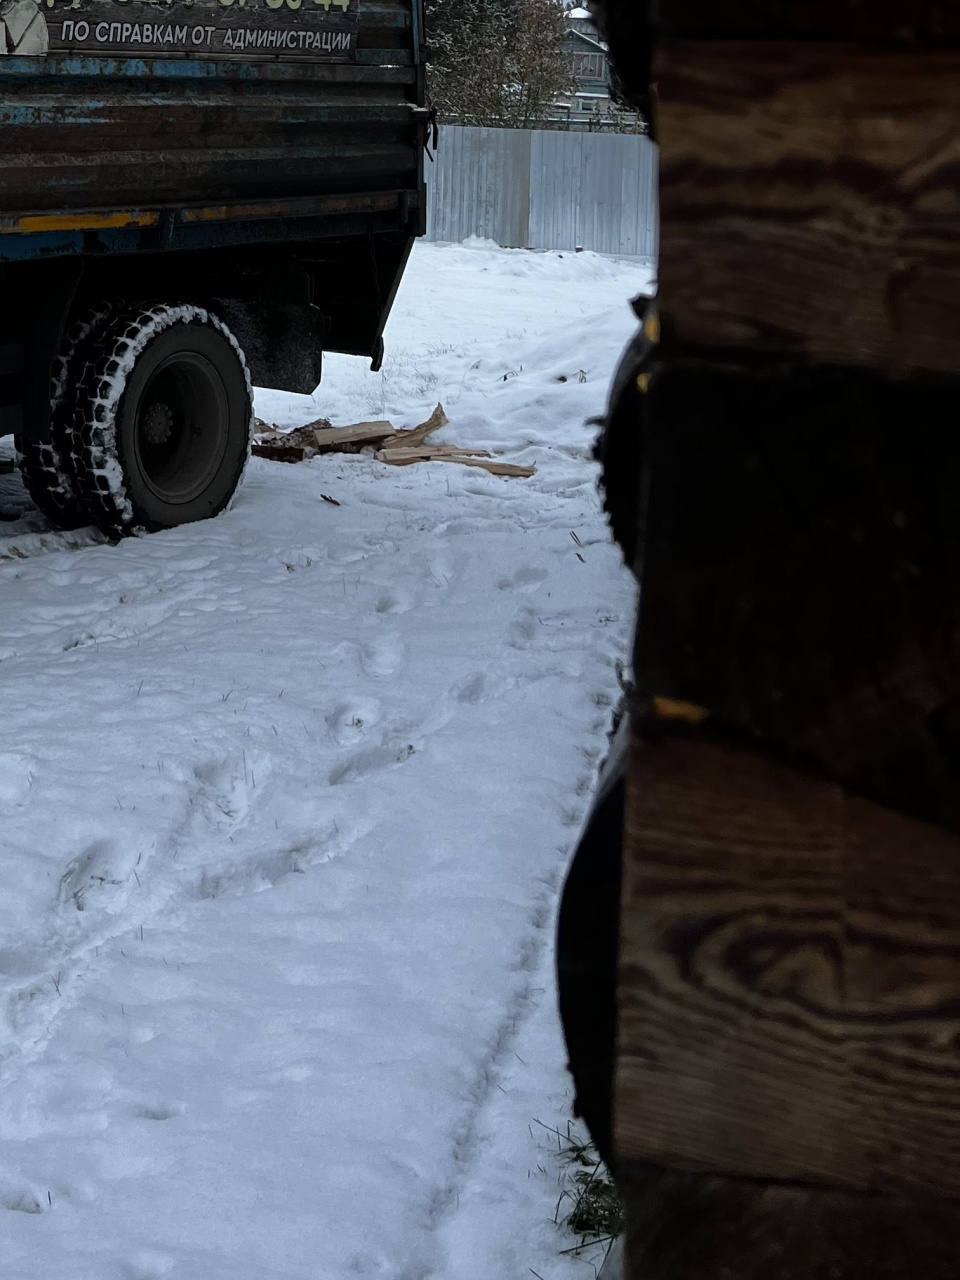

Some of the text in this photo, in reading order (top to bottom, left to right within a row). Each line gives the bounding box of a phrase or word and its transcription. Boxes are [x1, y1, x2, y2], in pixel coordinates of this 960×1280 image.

[61, 20, 351, 51] ПО СПРАВКАМ ОТ АДМИНИСТРАЦИИ
